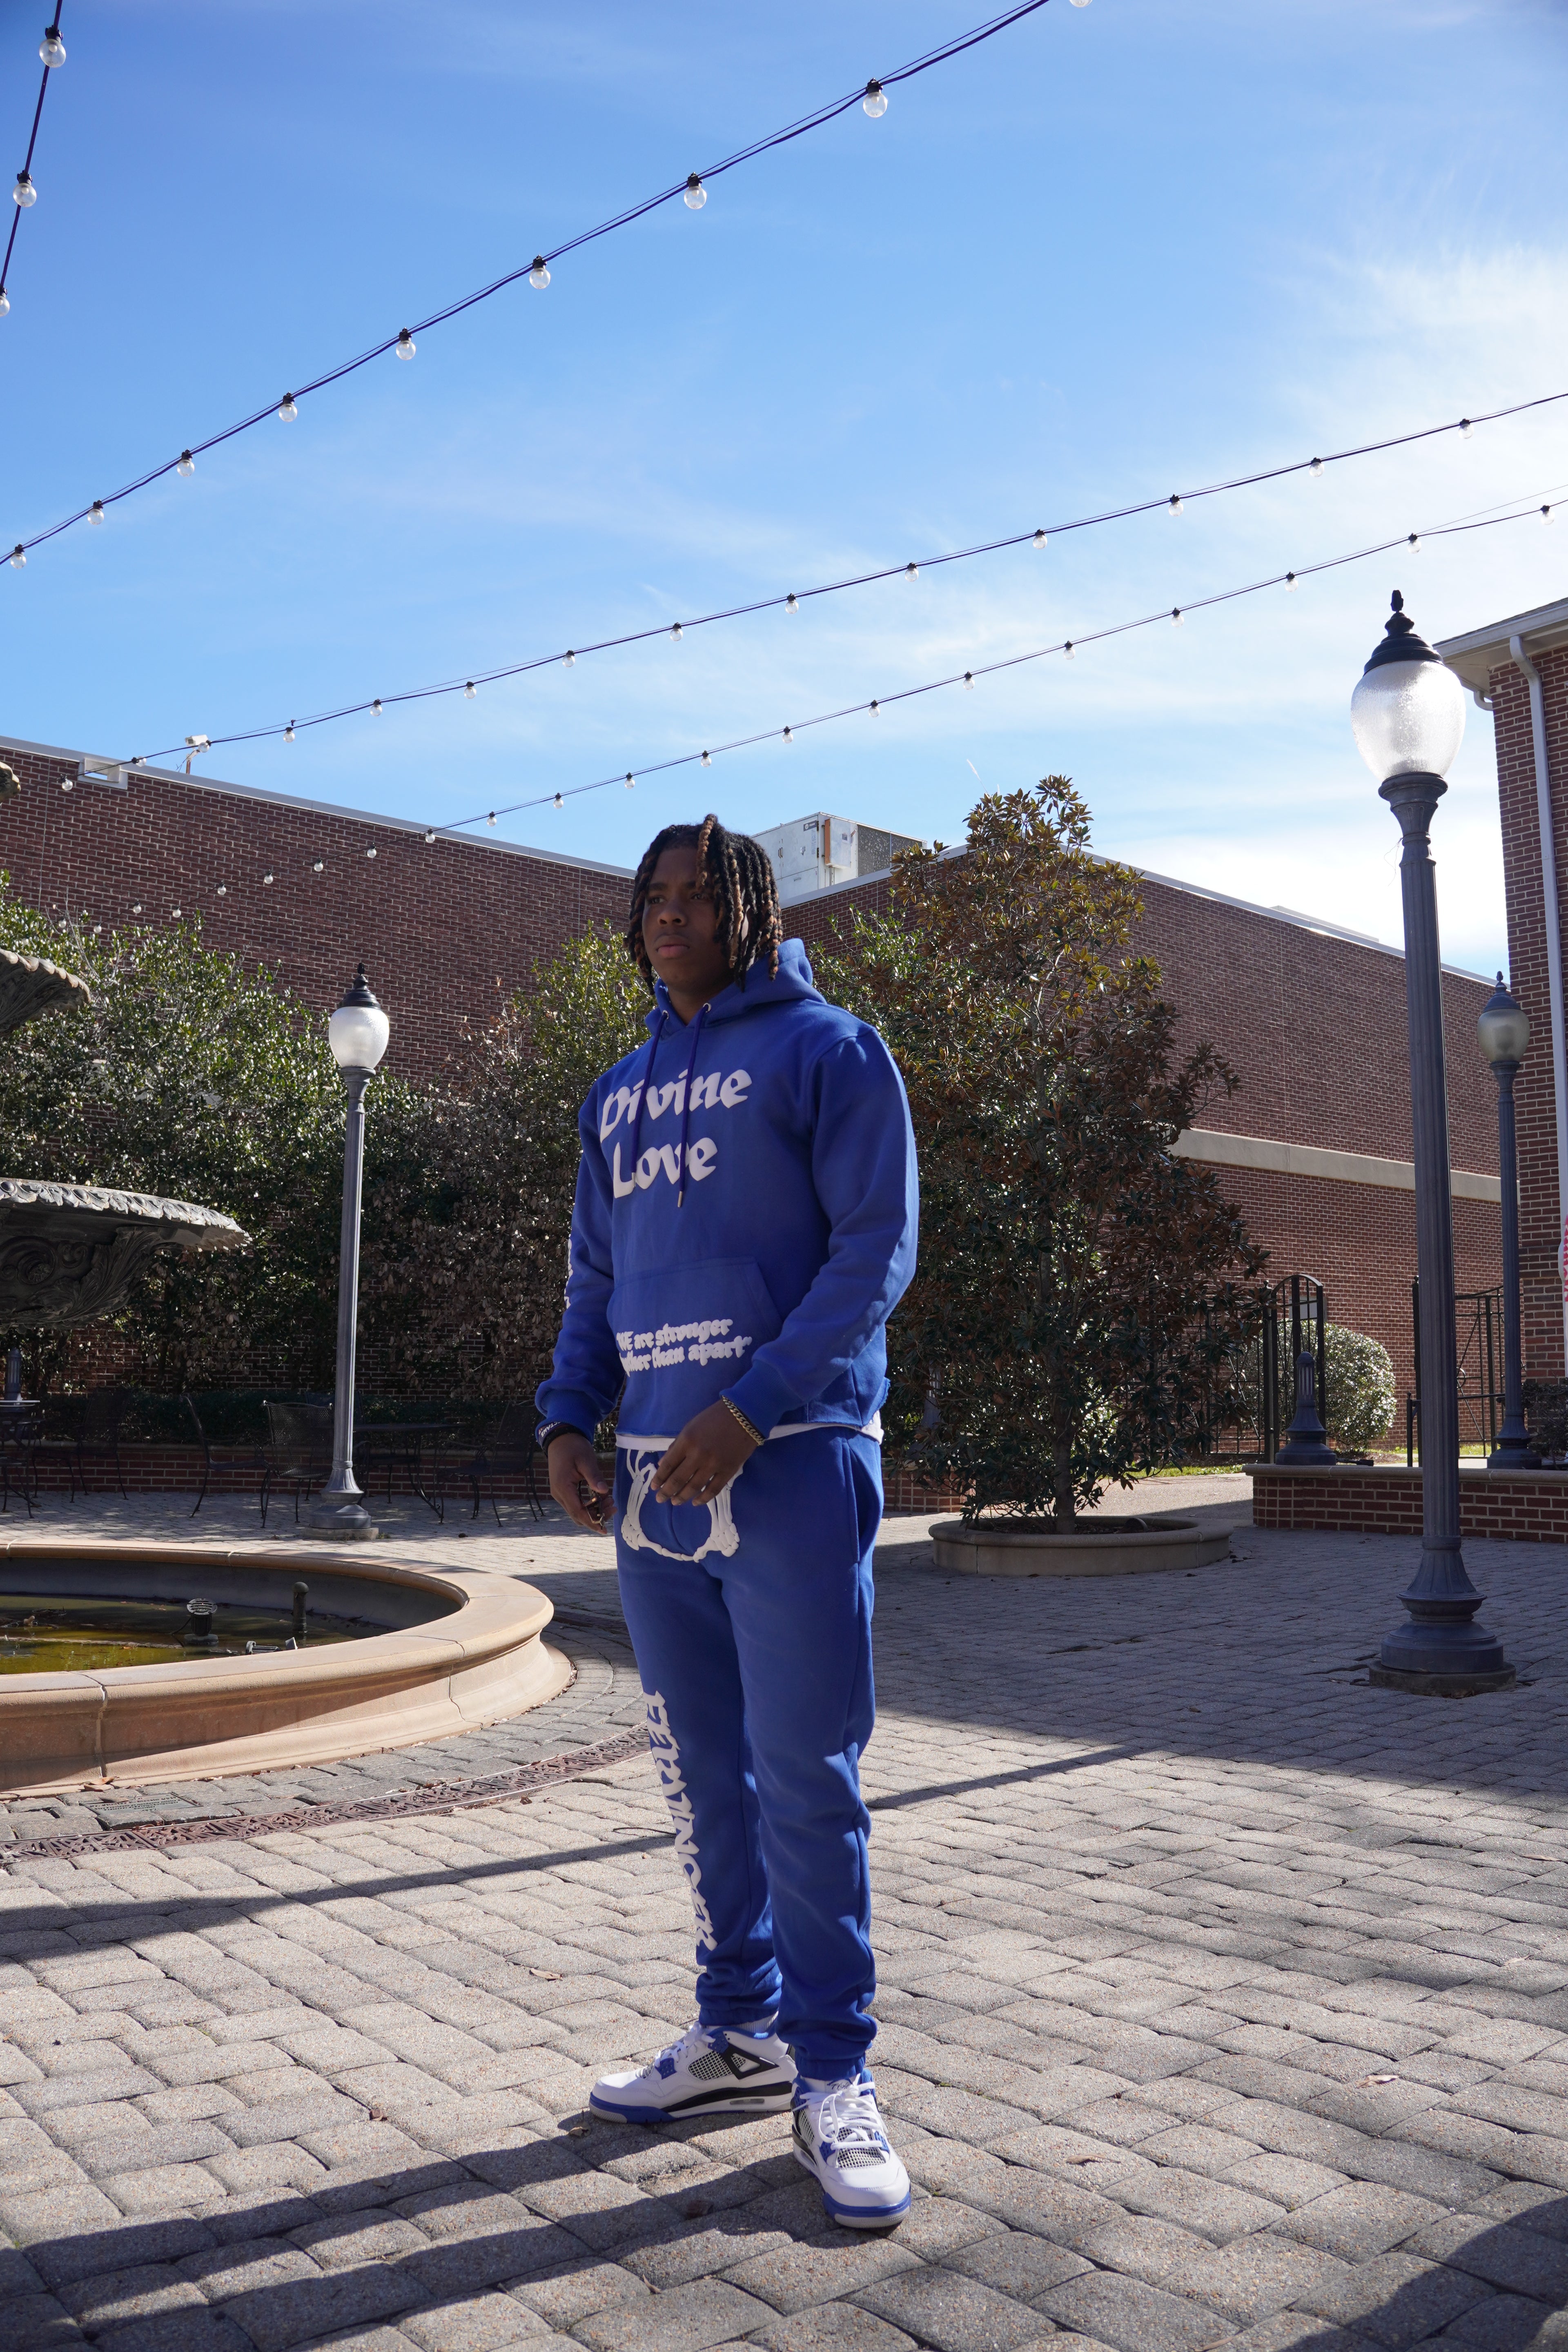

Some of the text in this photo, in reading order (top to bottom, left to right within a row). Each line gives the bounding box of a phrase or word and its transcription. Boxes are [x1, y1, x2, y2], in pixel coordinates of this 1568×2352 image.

[600, 1069, 753, 1144] Divine
[612, 1137, 718, 1199] Love
[634, 1332, 654, 1350] are
[655, 1319, 734, 1346] stronger
